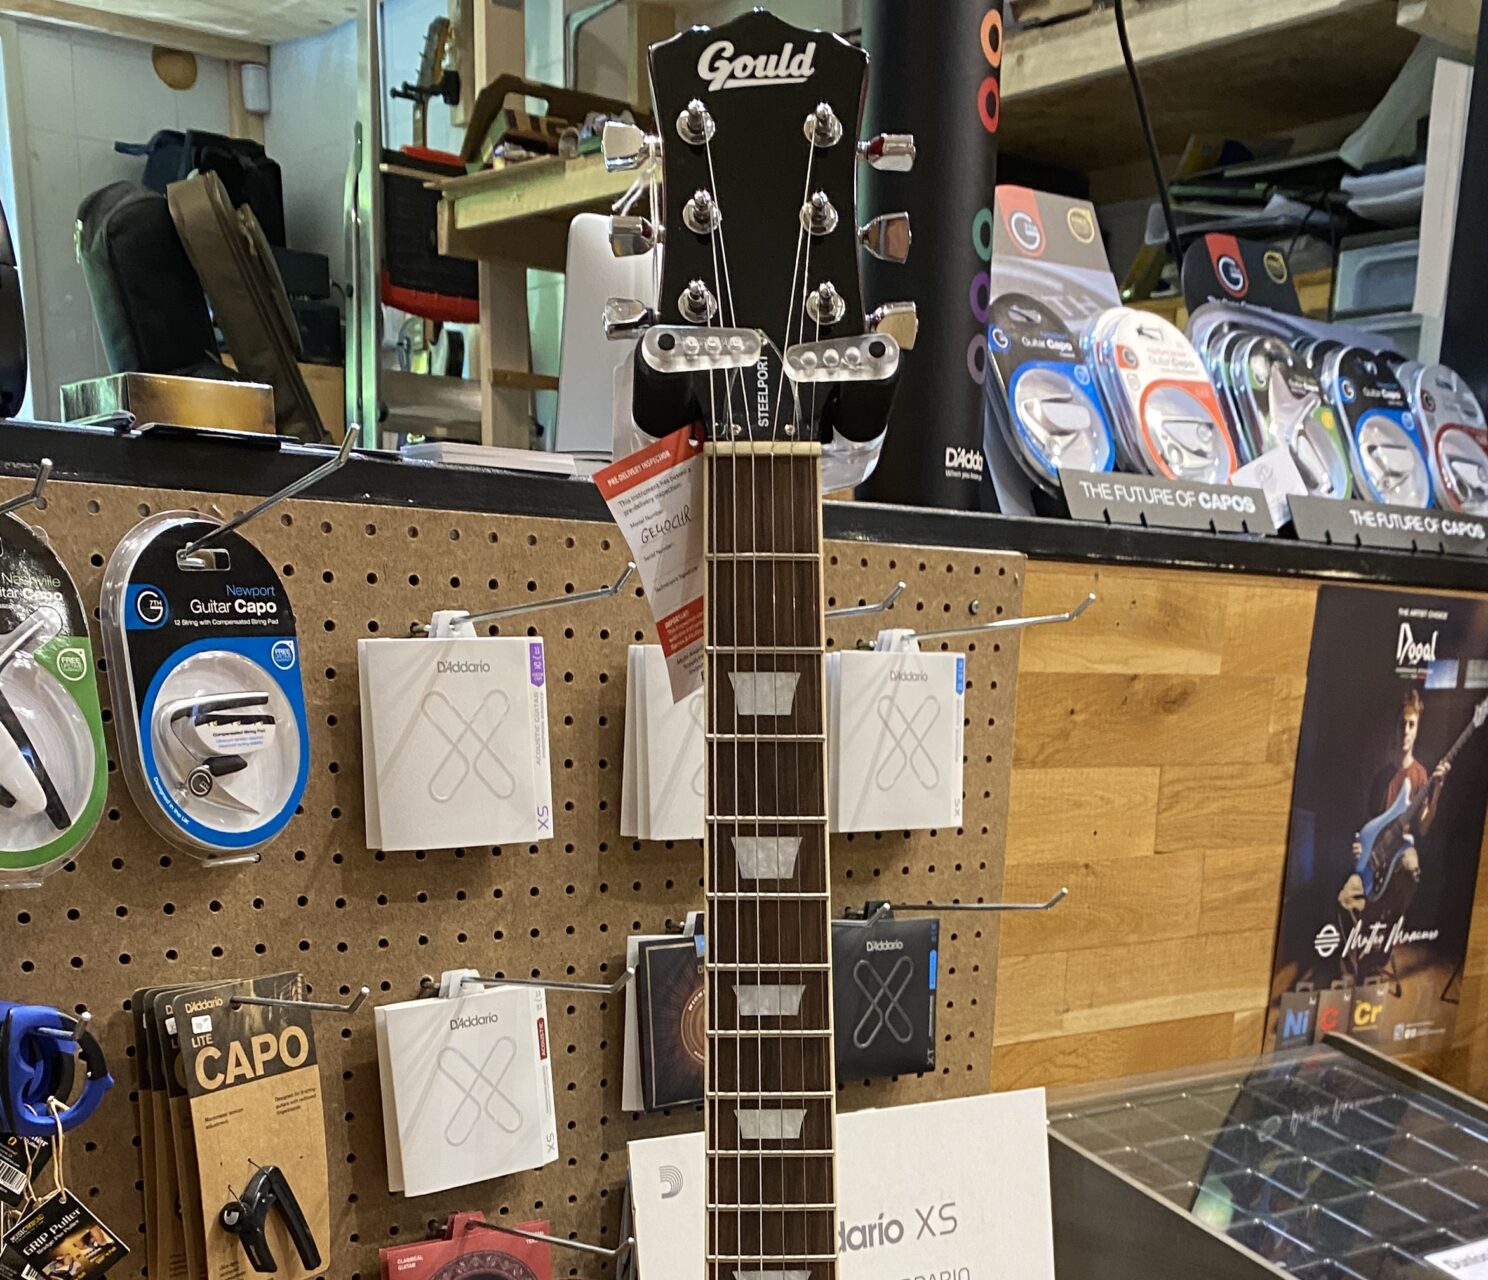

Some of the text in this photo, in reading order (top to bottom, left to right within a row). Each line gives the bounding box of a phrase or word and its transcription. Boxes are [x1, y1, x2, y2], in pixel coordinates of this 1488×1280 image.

[697, 40, 817, 92] Gould
[756, 355, 770, 427] STEELPORT
[1078, 480, 1257, 514] THE FUTURE OF CAPOS
[1349, 509, 1486, 540] THE FUTURE OF CAPOS
[1, 572, 61, 588] Nashville
[22, 588, 64, 601] Capo
[225, 584, 276, 598] Newport
[190, 598, 278, 616] Guitar Capo
[182, 618, 199, 627] String
[199, 618, 212, 626] with
[212, 618, 251, 627] Compensated
[251, 618, 268, 626] String
[436, 660, 491, 674] D'Addario
[889, 670, 929, 682] D'Addario
[153, 776, 170, 806] Designed
[537, 804, 549, 831] XS
[866, 939, 904, 952] D'Addario
[185, 996, 224, 1014] D'Addario
[1354, 1001, 1384, 1026] Cr
[449, 1012, 499, 1031] D'Addario
[191, 1033, 214, 1049] LITE
[538, 1021, 546, 1057] ACOUSTIC
[195, 1025, 309, 1090] CAPO
[546, 1132, 556, 1153] XS
[914, 1201, 958, 1241] XS
[22, 1207, 82, 1257] GRIP Puller
